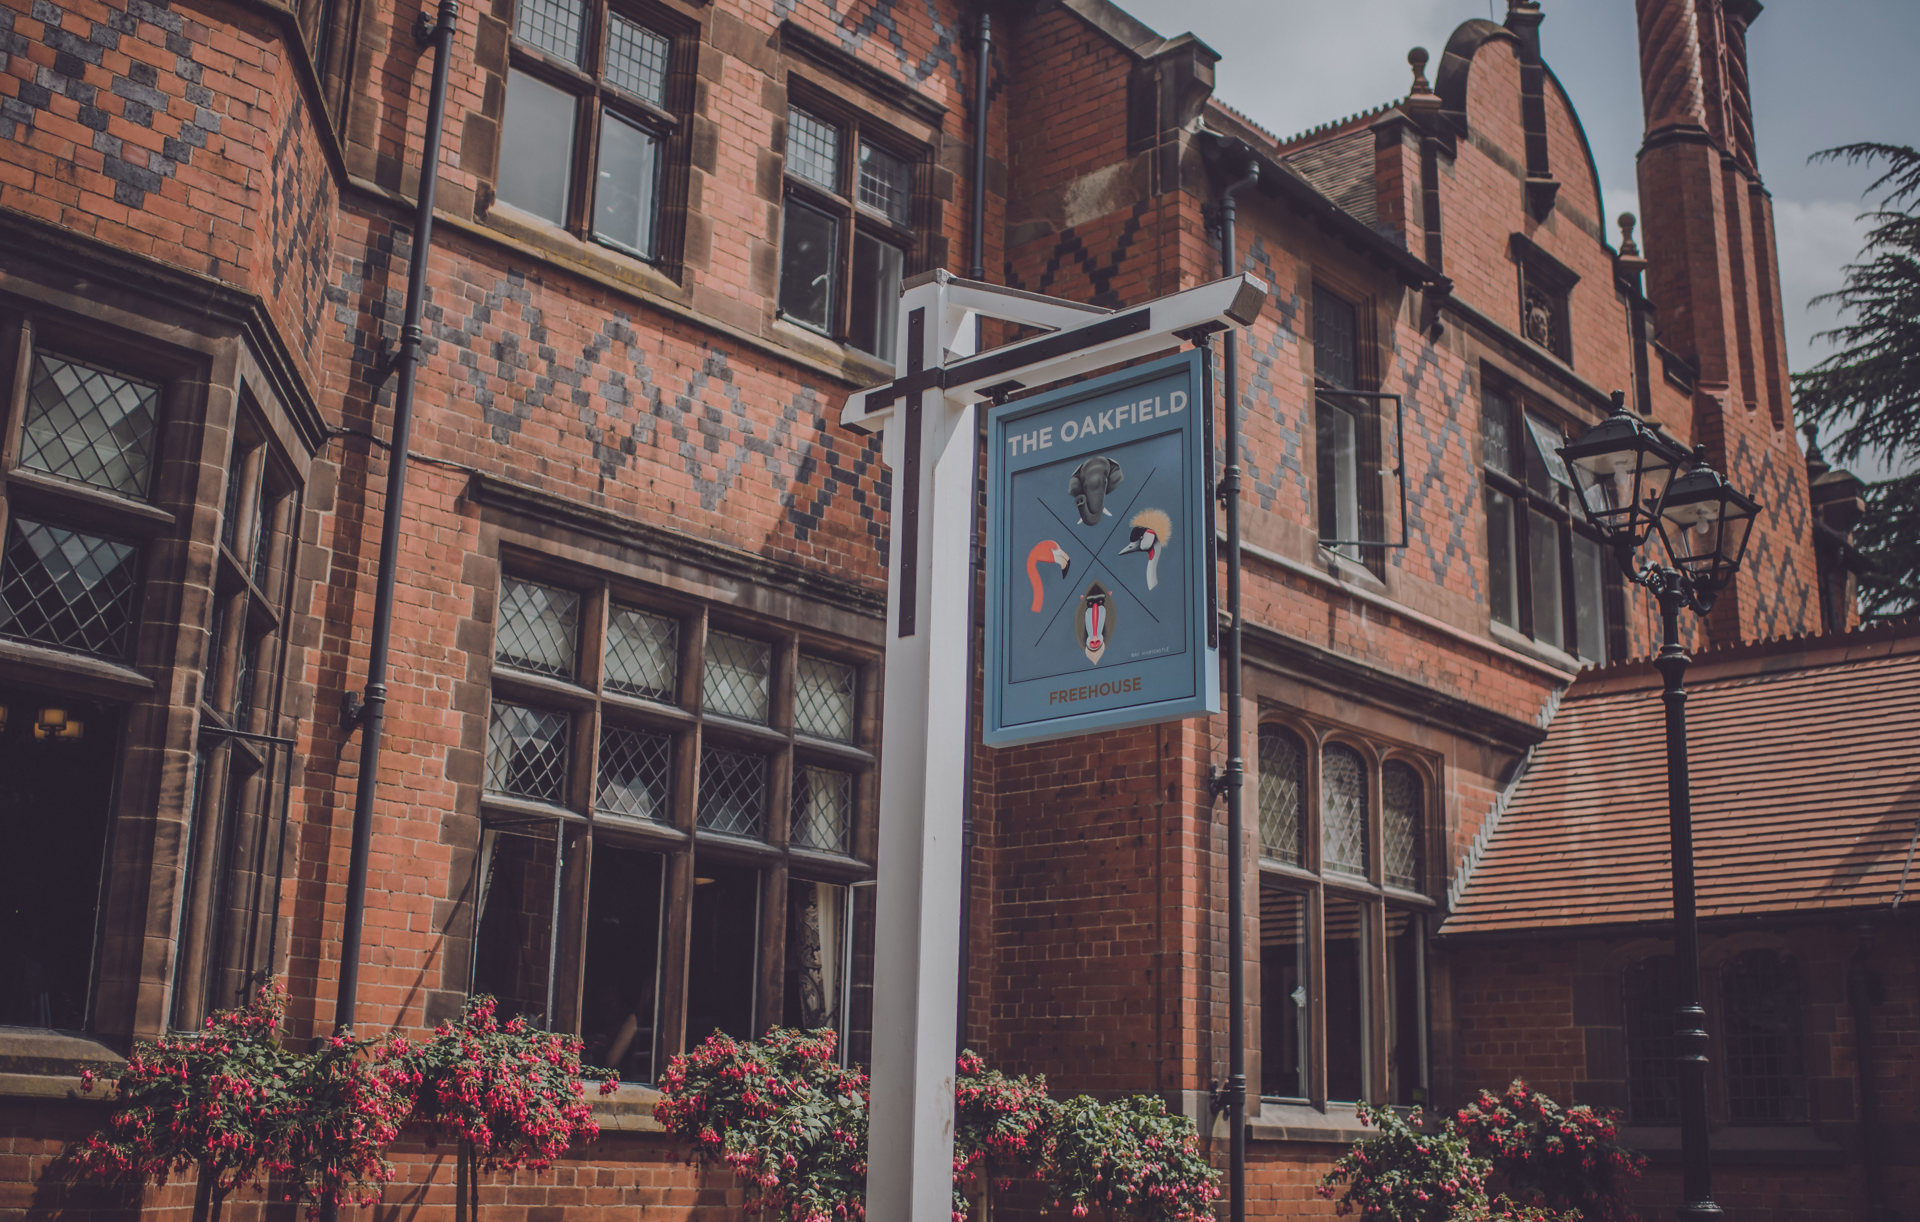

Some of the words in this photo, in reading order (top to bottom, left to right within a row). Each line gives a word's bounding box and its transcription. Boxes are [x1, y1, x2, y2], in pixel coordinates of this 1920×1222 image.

[1007, 426, 1053, 457] THE
[1060, 390, 1188, 442] OAKFIELD
[1049, 677, 1142, 705] FREEHOUSE
